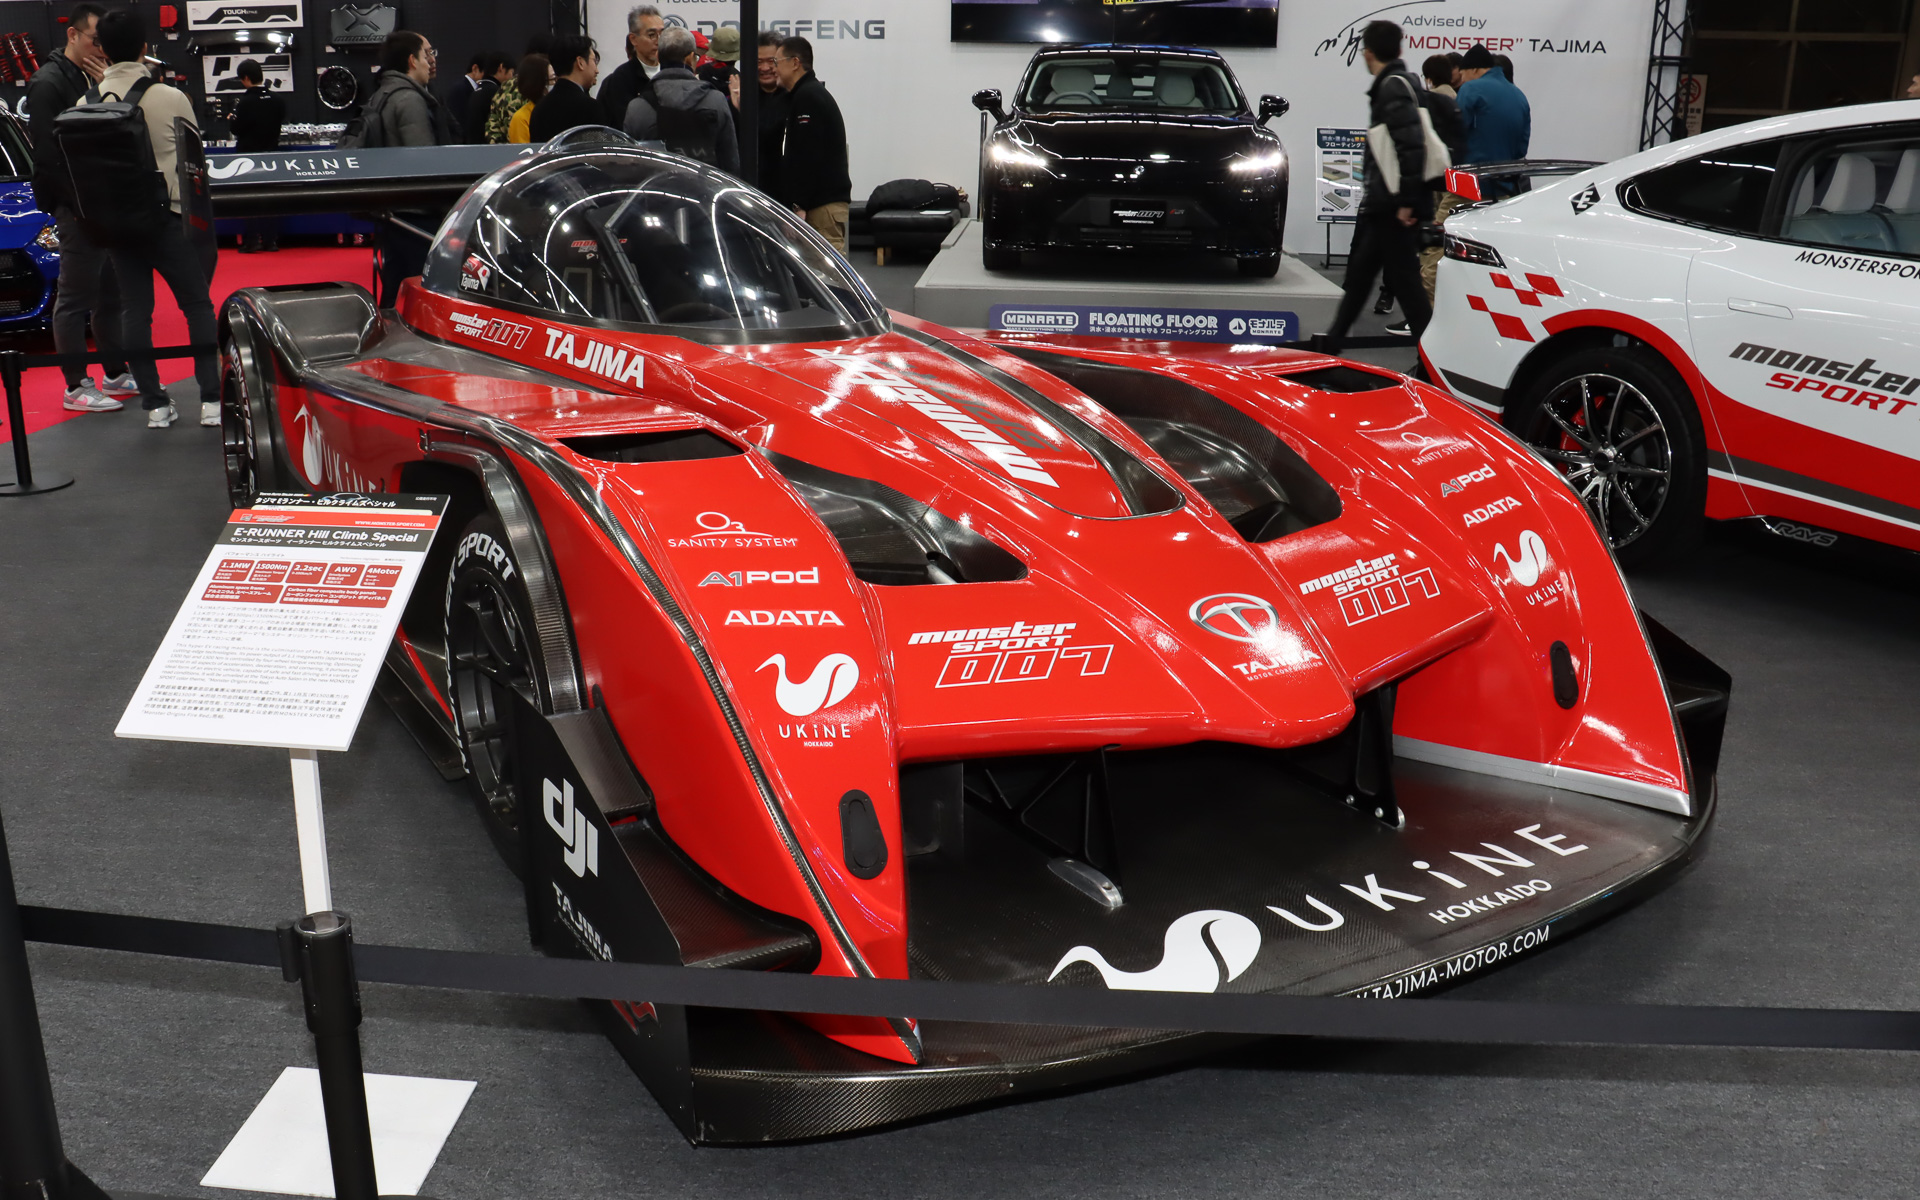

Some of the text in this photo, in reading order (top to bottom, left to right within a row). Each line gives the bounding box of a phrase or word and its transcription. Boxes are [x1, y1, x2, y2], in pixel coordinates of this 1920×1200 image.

[1402, 15, 1487, 29] Advised by
[1528, 39, 1608, 54] TAJIMA
[1577, 190, 1594, 209] E
[1006, 315, 1074, 325] MONARTE
[1089, 312, 1218, 329] FLOATING FLOOR
[450, 311, 533, 350] monster 007
[454, 324, 483, 338] SPORT
[544, 327, 645, 389] TAJIMA
[1765, 372, 1919, 415] SPORT
[1412, 449, 1443, 466] SANITY
[1462, 496, 1523, 528] ADATA
[234, 527, 419, 543] E-RUNNER Hill Climb Special
[667, 538, 728, 547] SANITY
[1774, 522, 1838, 546] RAYS
[457, 532, 517, 581] SPORT
[256, 563, 289, 571] 1500Nm
[293, 564, 324, 572] 2.2sec
[367, 567, 400, 575] 4Motor
[1299, 553, 1397, 595] monster
[1333, 565, 1400, 596] SPORT
[1337, 567, 1441, 627] 007
[724, 610, 845, 626] ADATA
[907, 620, 1077, 645] monster
[950, 635, 1072, 653] SPORT
[934, 644, 1115, 688] 007
[1246, 670, 1274, 681] MOTOR
[1428, 879, 1552, 925] HOKKAIDO
[552, 881, 613, 962] TAJIMA
